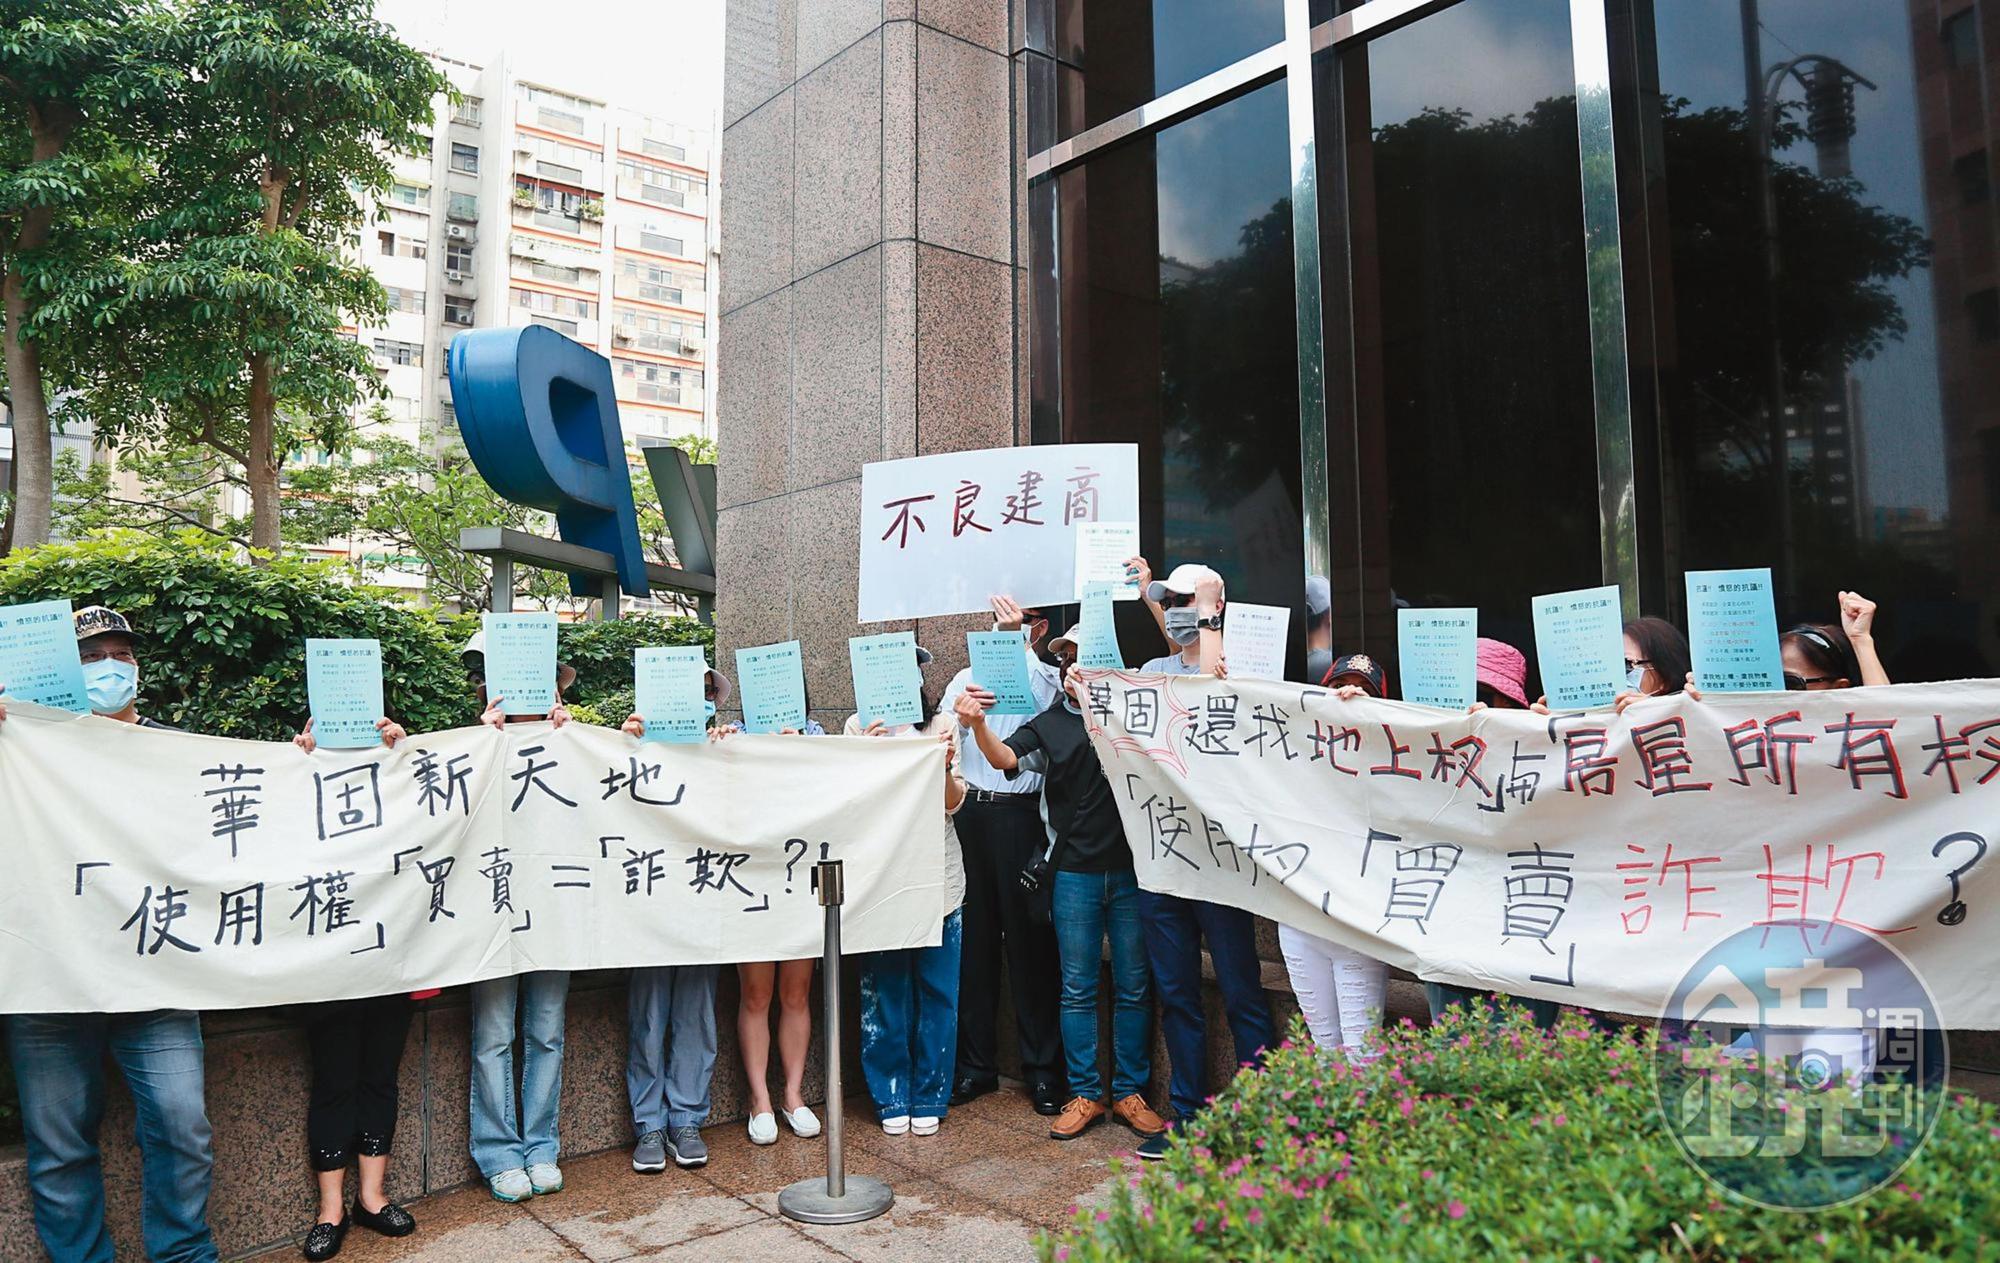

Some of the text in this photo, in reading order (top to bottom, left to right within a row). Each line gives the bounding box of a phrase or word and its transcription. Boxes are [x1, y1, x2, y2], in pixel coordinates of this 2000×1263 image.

[881, 465, 1100, 549] 不良建商
[200, 745, 686, 861] 華固新天地
